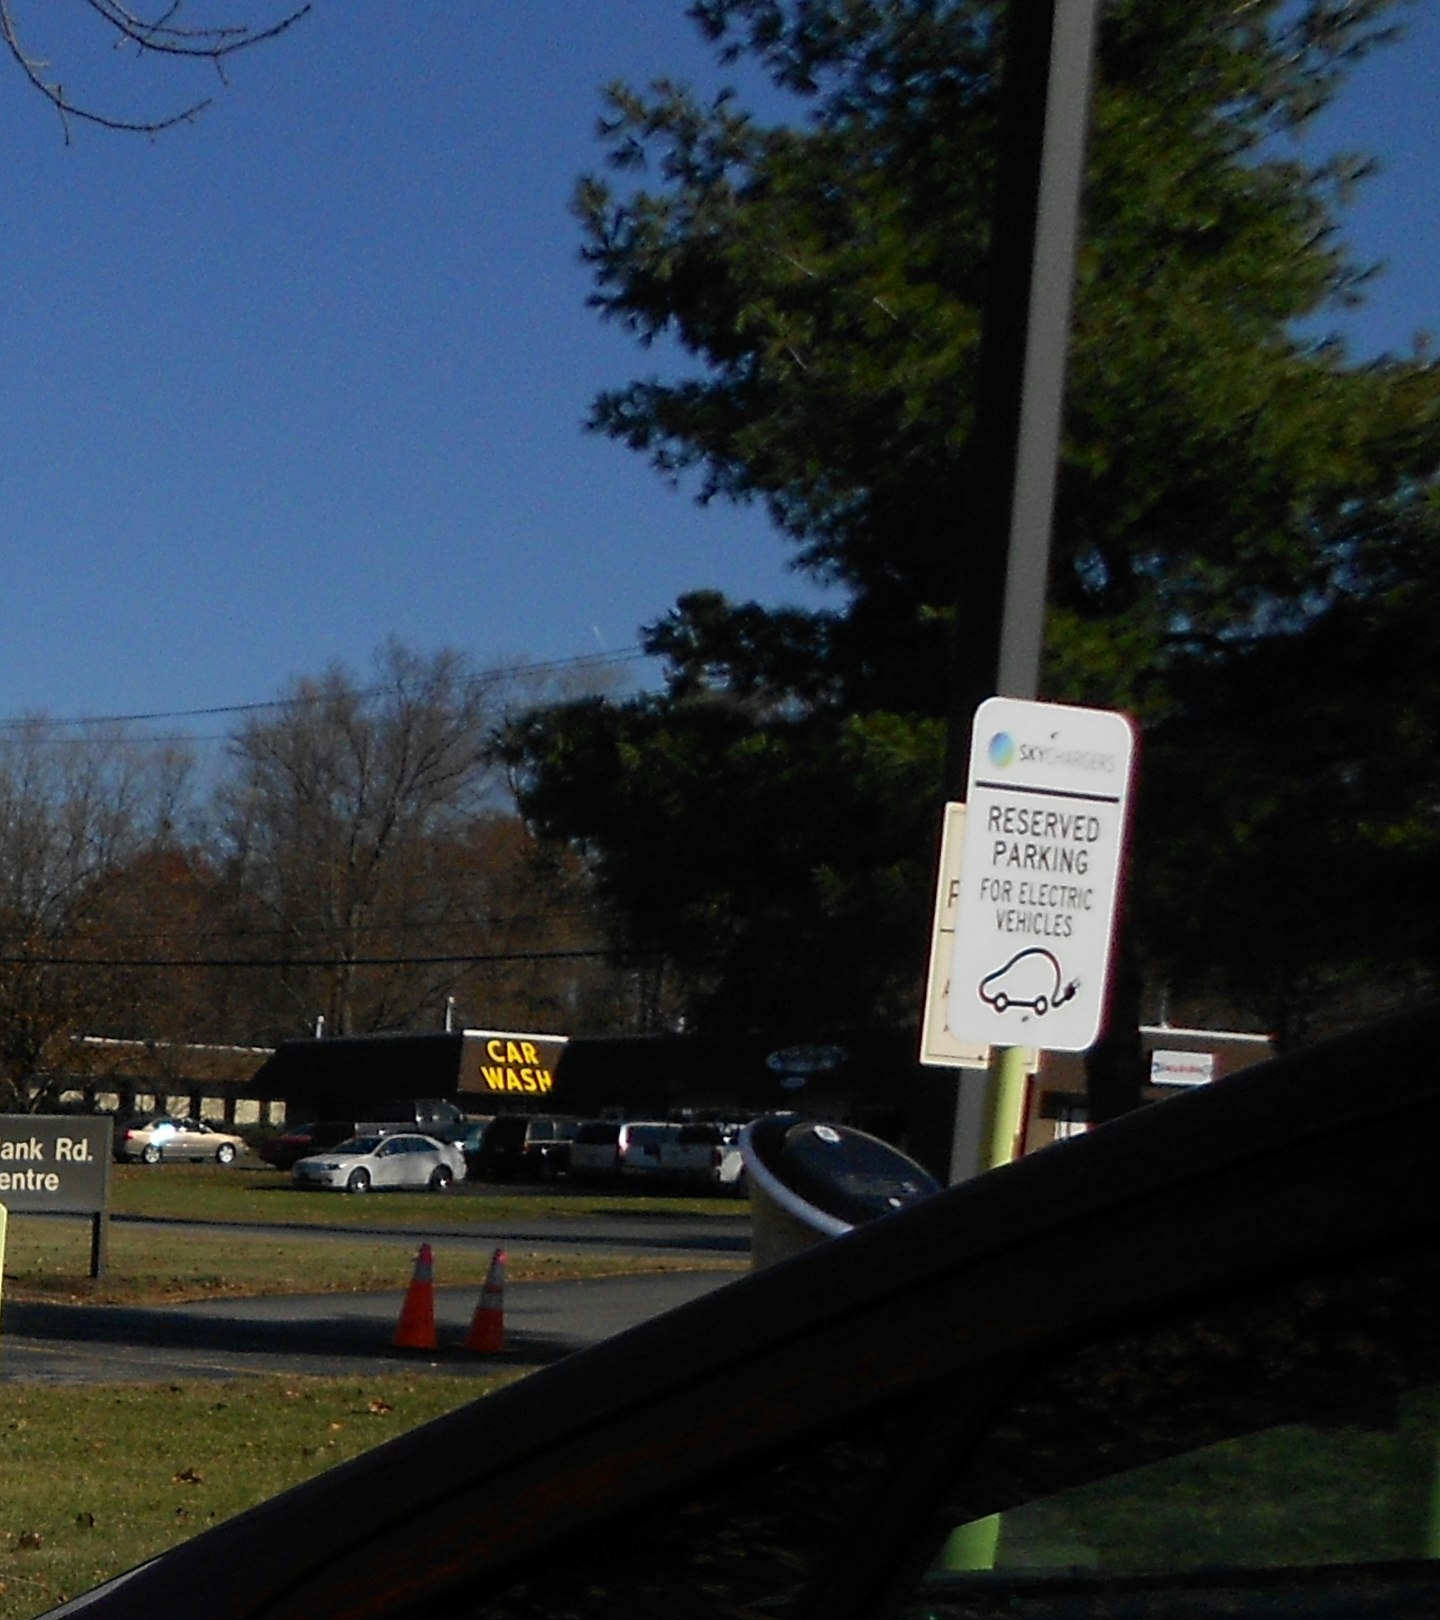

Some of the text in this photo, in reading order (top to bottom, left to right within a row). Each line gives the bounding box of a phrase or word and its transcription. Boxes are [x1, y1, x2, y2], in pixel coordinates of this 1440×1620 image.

[988, 805, 1100, 843] RESERVED
[992, 840, 1089, 875] PARKING
[980, 878, 1013, 902] FOR
[1019, 882, 1094, 911] ELECTRIC
[995, 909, 1073, 938] VEHICLES
[487, 1040, 540, 1065] CAR
[480, 1066, 553, 1092] WASH
[55, 1137, 94, 1162] Rd.
